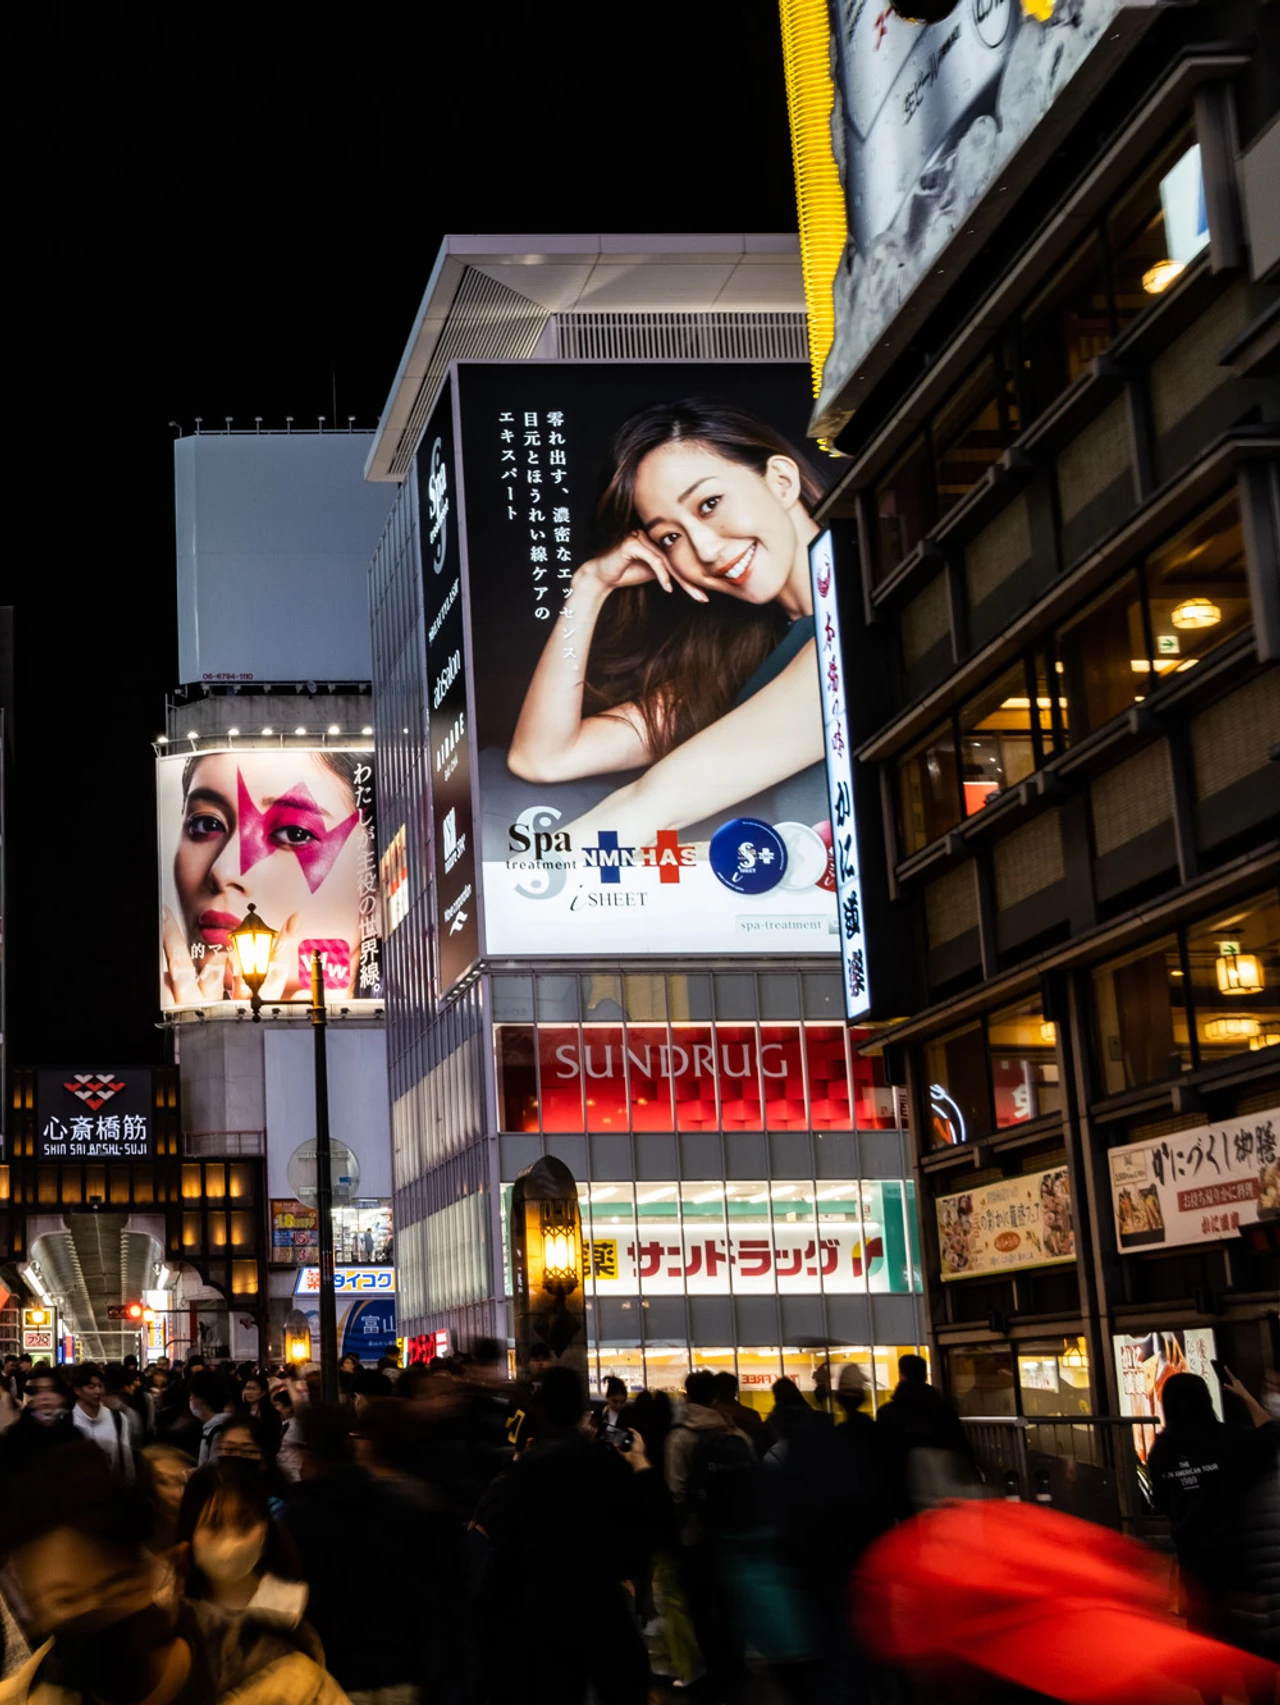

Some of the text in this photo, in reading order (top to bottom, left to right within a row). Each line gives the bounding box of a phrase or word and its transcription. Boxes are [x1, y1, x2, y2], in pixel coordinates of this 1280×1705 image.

[498, 410, 519, 521] エキスパート
[522, 411, 551, 622] 目元とほうれい線ケアの
[507, 823, 573, 860] Spa
[641, 846, 697, 867] HAS
[353, 762, 381, 993] わたしが主役の世界線。
[506, 859, 577, 870] treatment
[588, 891, 648, 907] SHEET
[740, 920, 822, 932] spa-treatment
[555, 1044, 789, 1080] SUNDRUG
[42, 1114, 148, 1142] 心斎橋筋
[43, 1143, 67, 1157] SHIN
[69, 1143, 87, 1157] SAI
[580, 1238, 839, 1278] 薬 サンドラッグ
